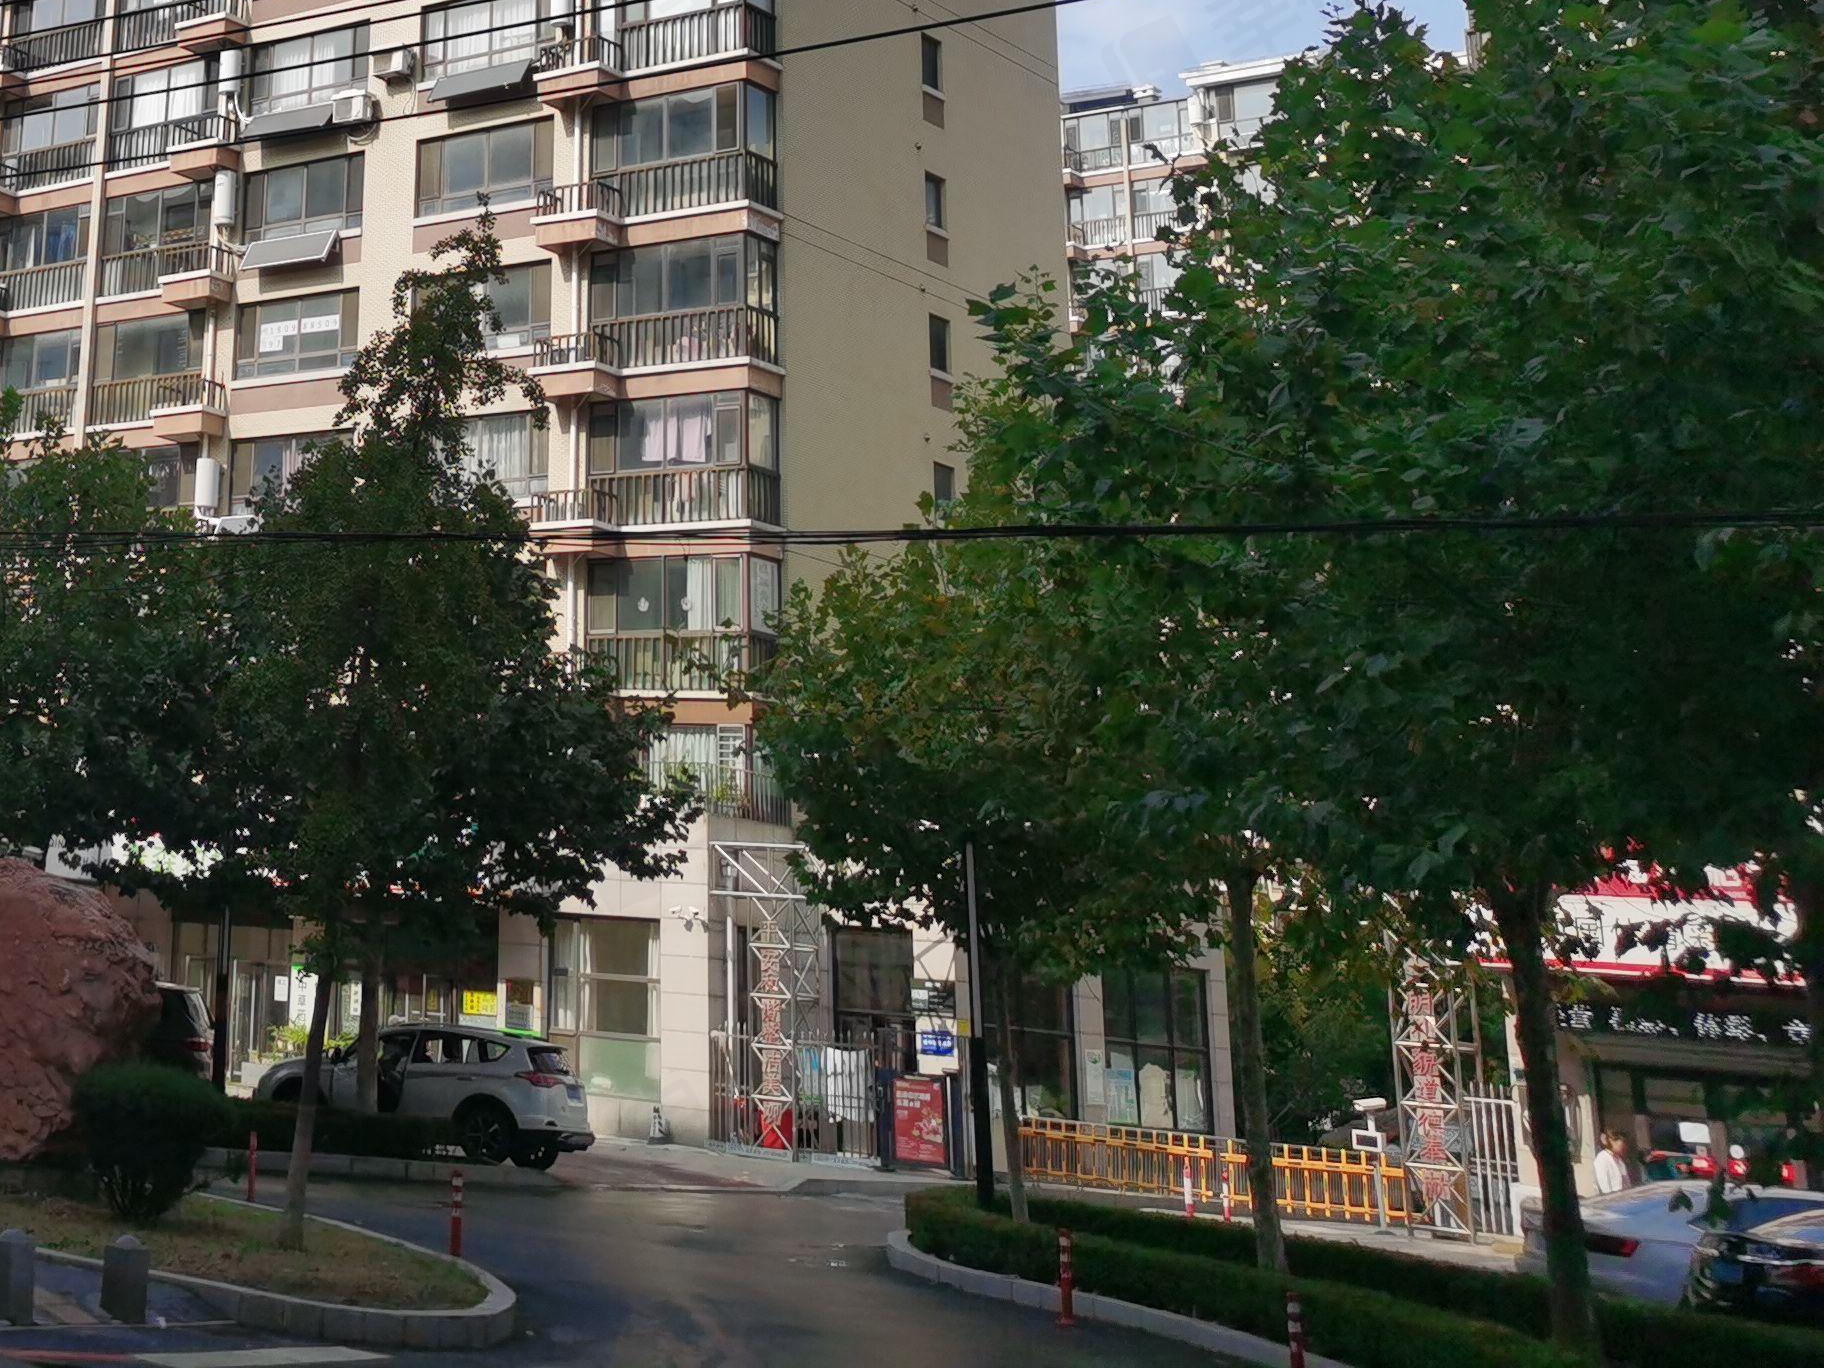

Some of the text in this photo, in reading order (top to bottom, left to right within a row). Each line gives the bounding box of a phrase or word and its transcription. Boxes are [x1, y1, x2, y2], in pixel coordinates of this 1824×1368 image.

[1404, 960, 1452, 1202] 明礼貌道德奉献
